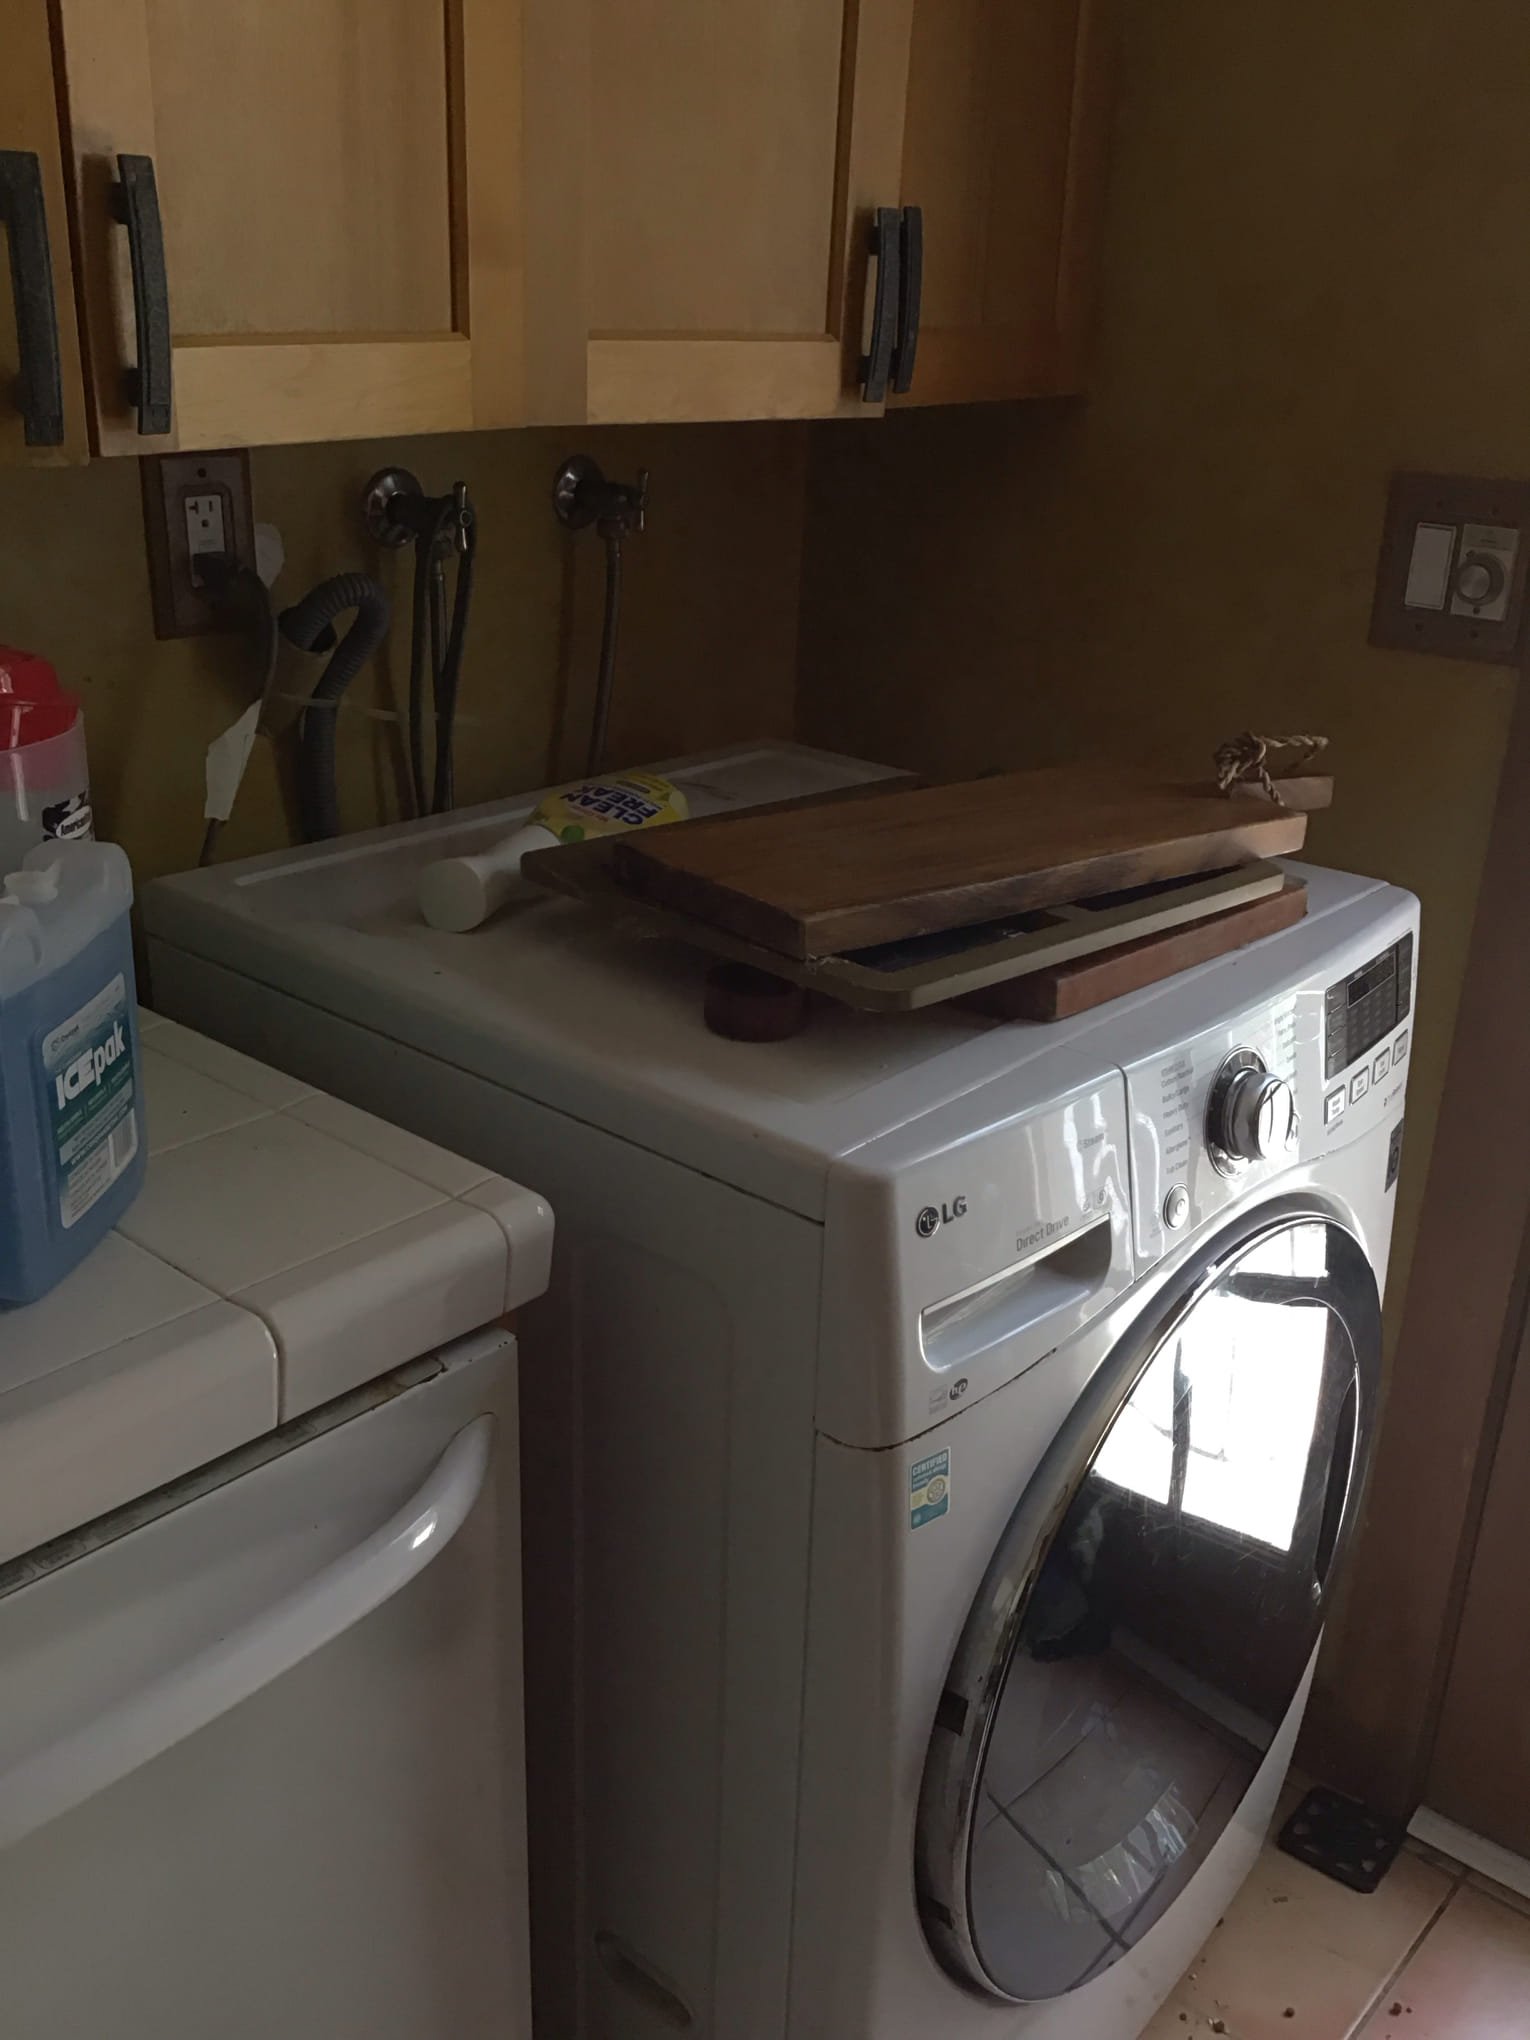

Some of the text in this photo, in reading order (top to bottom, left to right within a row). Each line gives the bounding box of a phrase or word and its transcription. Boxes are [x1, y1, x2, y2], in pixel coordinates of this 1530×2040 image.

[559, 793, 644, 825] CLEAN
[942, 1195, 967, 1224] LG
[1016, 1228, 1044, 1252] Direct
[1046, 1216, 1069, 1236] Drive
